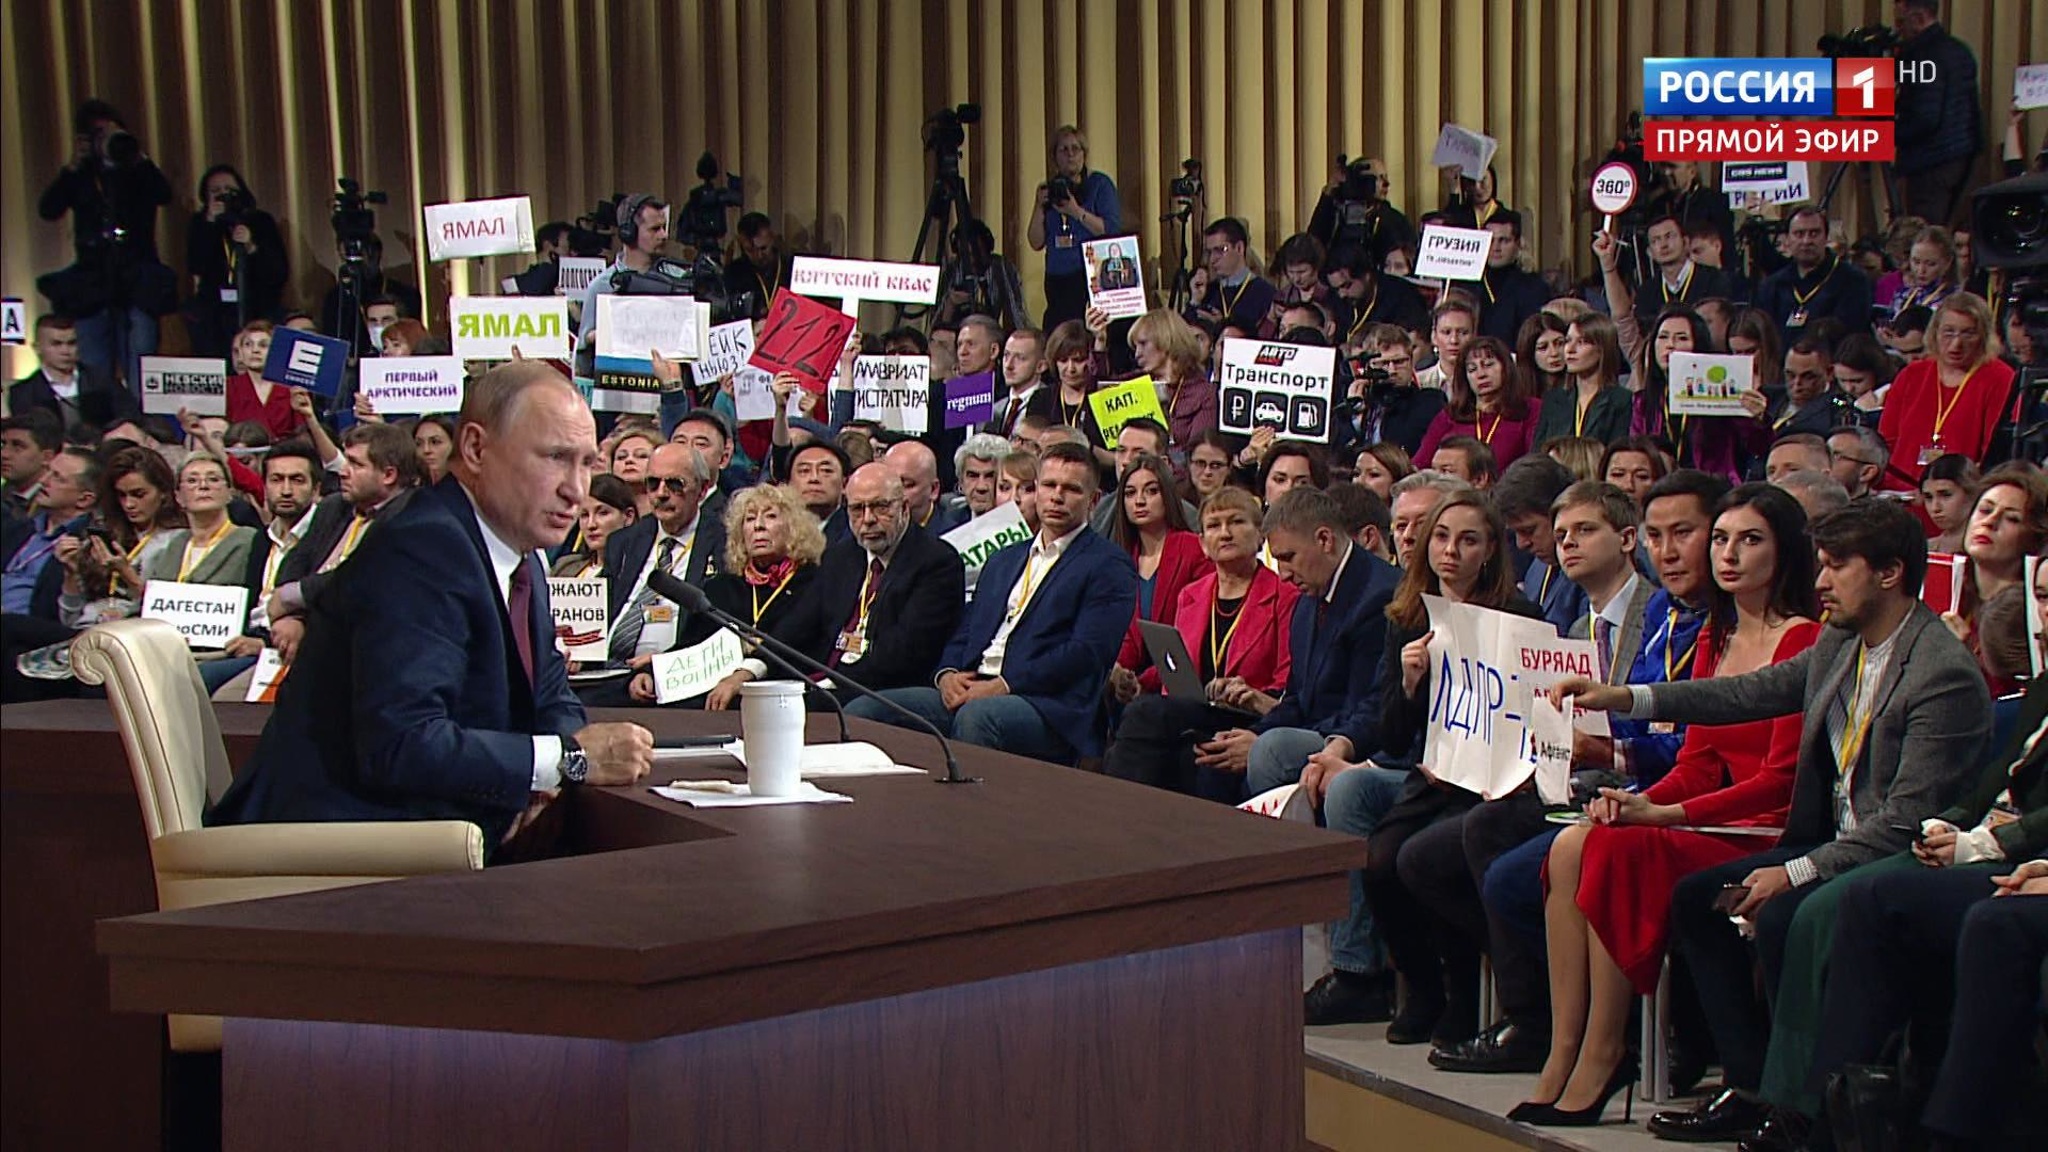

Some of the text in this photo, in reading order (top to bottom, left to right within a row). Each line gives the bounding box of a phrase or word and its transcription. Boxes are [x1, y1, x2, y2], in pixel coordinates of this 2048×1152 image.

[442, 217, 506, 240] ЯМАЛ
[1428, 235, 1481, 253] ГРУЗИЯ
[886, 275, 932, 293] КВАС
[458, 312, 561, 339] ЯМАЛ
[385, 368, 438, 383] ПЕРВЫЙ
[601, 374, 660, 389] ESTONIA
[1225, 363, 1329, 391] Транспорт
[366, 384, 458, 399] АРКТИЧЕСКИЙ
[947, 392, 992, 412] regnum
[1105, 391, 1138, 414] КАП.
[552, 583, 602, 597] ЖАЮТ
[150, 598, 236, 615] ДАГЕСТАН
[1521, 647, 1593, 681] БУРЯАД
